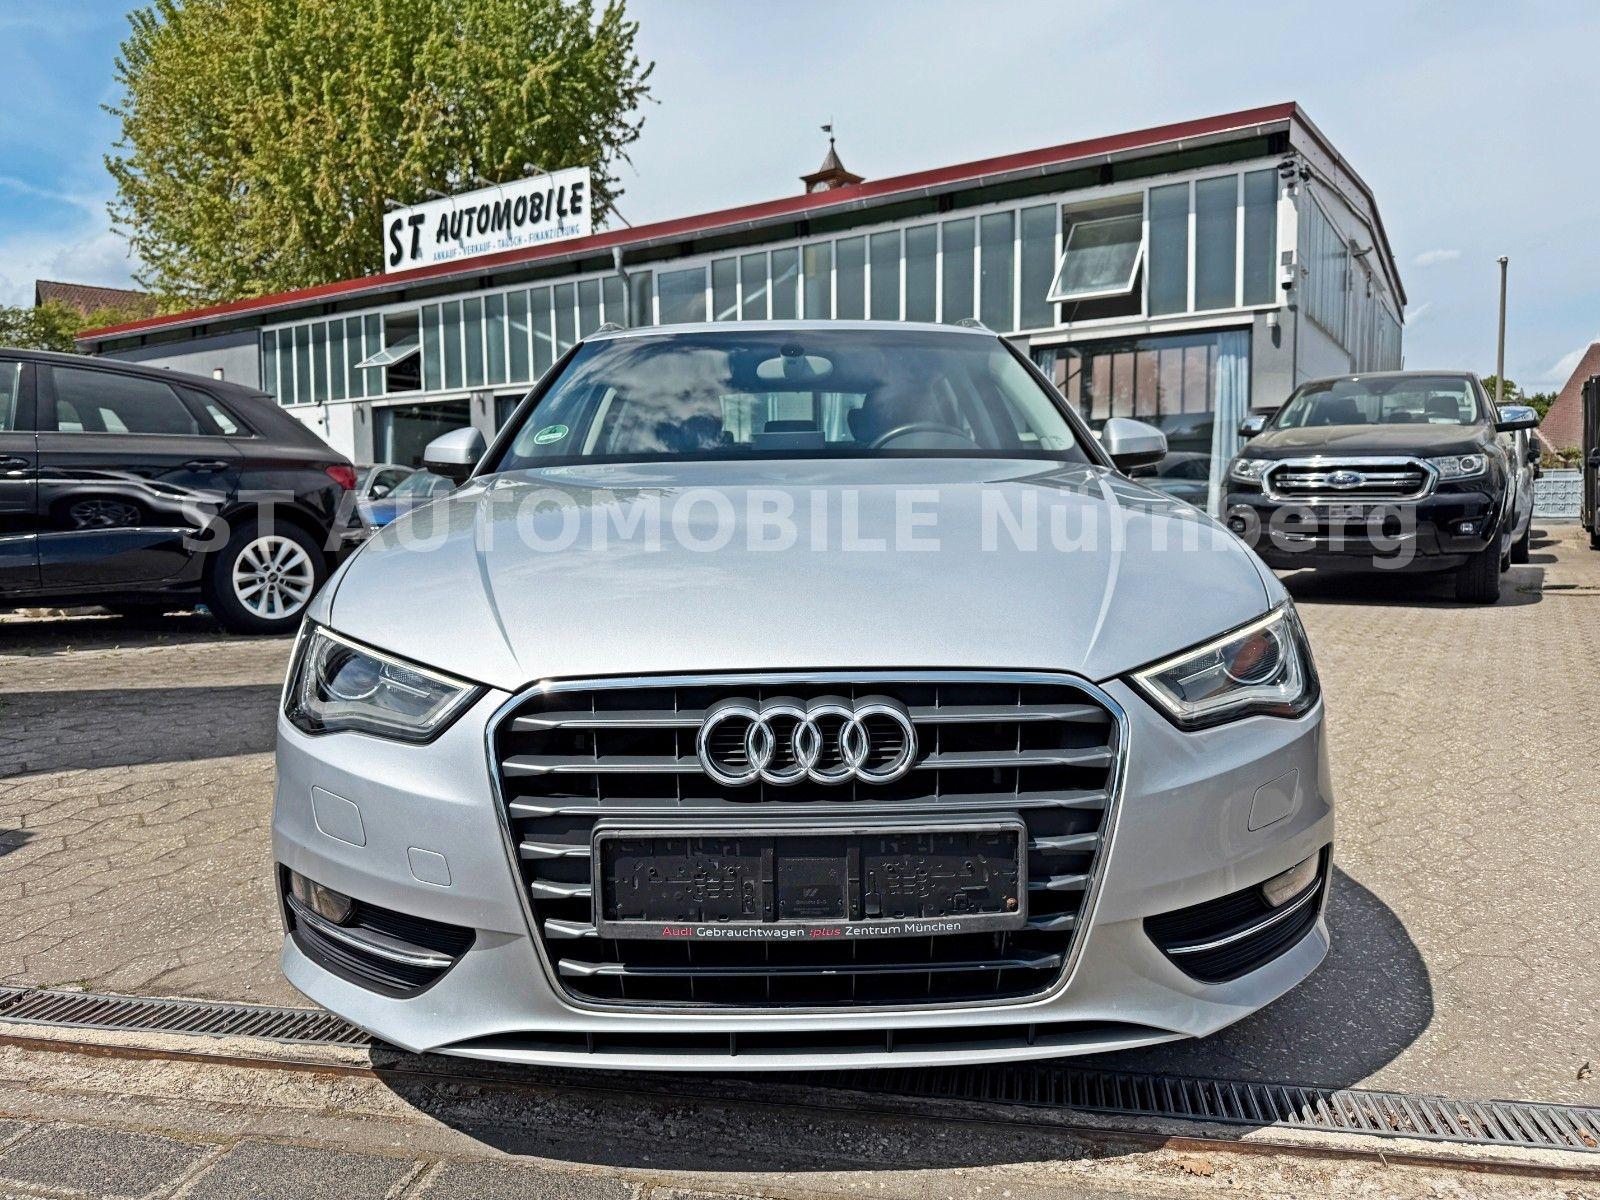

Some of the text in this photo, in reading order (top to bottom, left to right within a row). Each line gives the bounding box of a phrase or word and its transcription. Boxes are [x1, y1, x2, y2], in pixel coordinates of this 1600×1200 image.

[389, 182, 584, 267] ST AUTOMOBILE
[662, 926, 692, 936] Audi
[696, 927, 805, 939] Gebrauchtwagen
[845, 925, 901, 936] Zentrum
[904, 921, 961, 933] München
